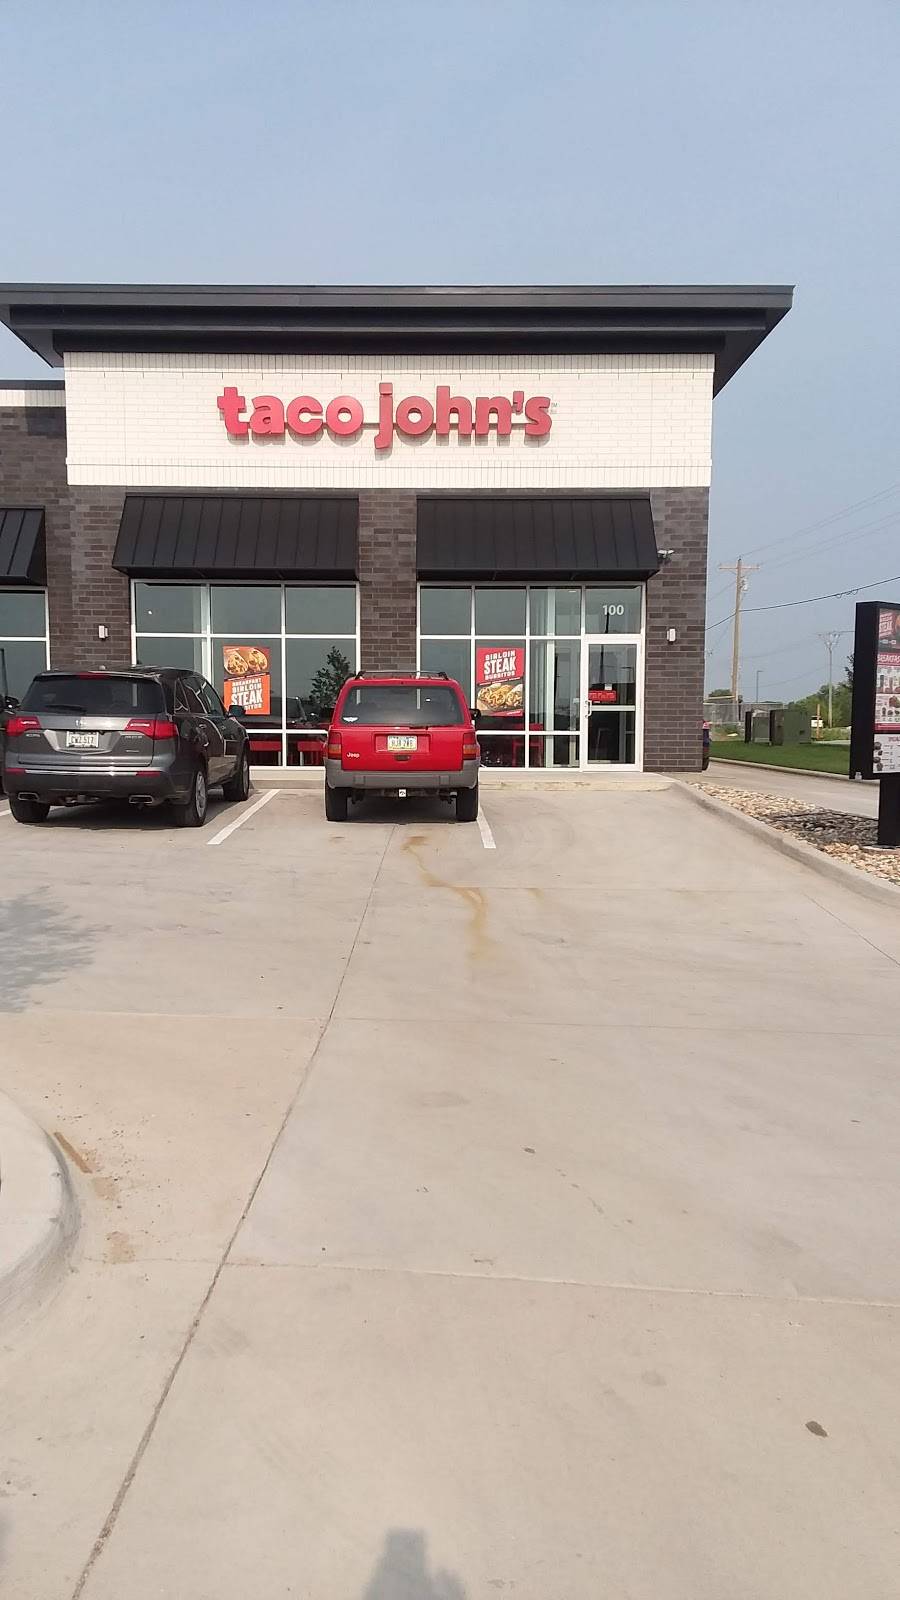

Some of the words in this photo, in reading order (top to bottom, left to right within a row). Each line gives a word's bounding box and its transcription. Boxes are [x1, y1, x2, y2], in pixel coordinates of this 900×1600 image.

[216, 386, 365, 436] taco
[374, 382, 553, 449] john's
[602, 604, 625, 616] 100
[485, 650, 516, 661] SIRLOIN
[484, 656, 517, 675] STEAK
[484, 670, 516, 681] BURRITOS
[232, 682, 262, 694] SIRLOIN
[231, 688, 263, 706] STEAK
